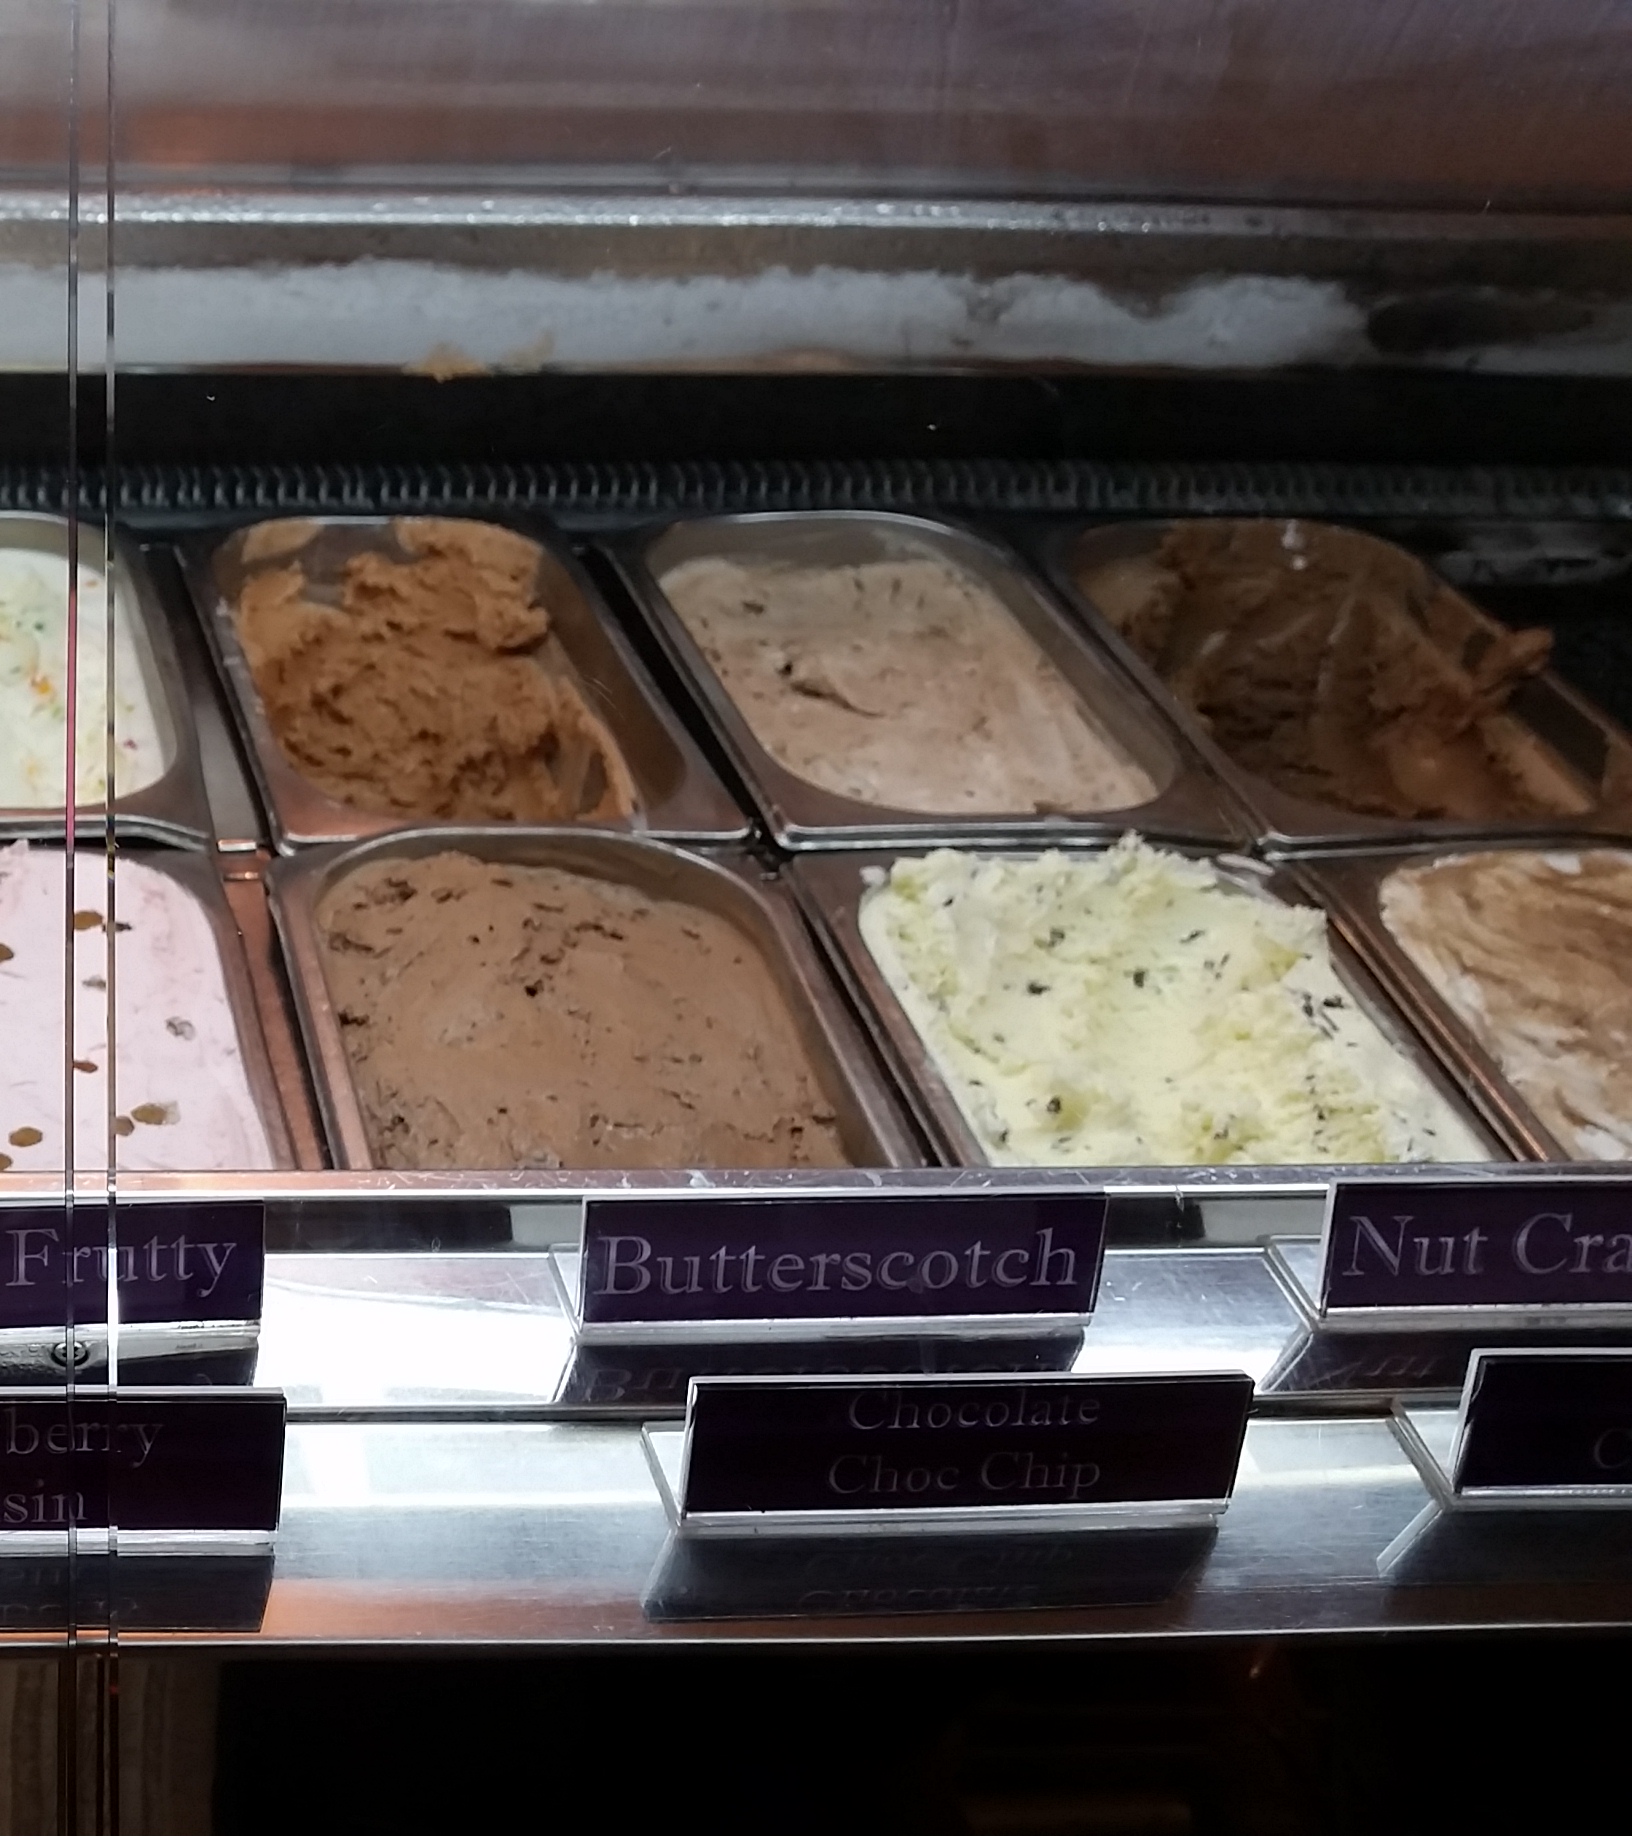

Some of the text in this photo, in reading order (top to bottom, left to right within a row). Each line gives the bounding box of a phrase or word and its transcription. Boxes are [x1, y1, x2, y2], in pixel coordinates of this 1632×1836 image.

[5, 1228, 237, 1298] Frutty
[594, 1228, 1079, 1295] Butterscotch
[1342, 1215, 1489, 1277] Nut
[848, 1390, 1101, 1430] Chocolate
[828, 1450, 1101, 1497] Choc Chip
